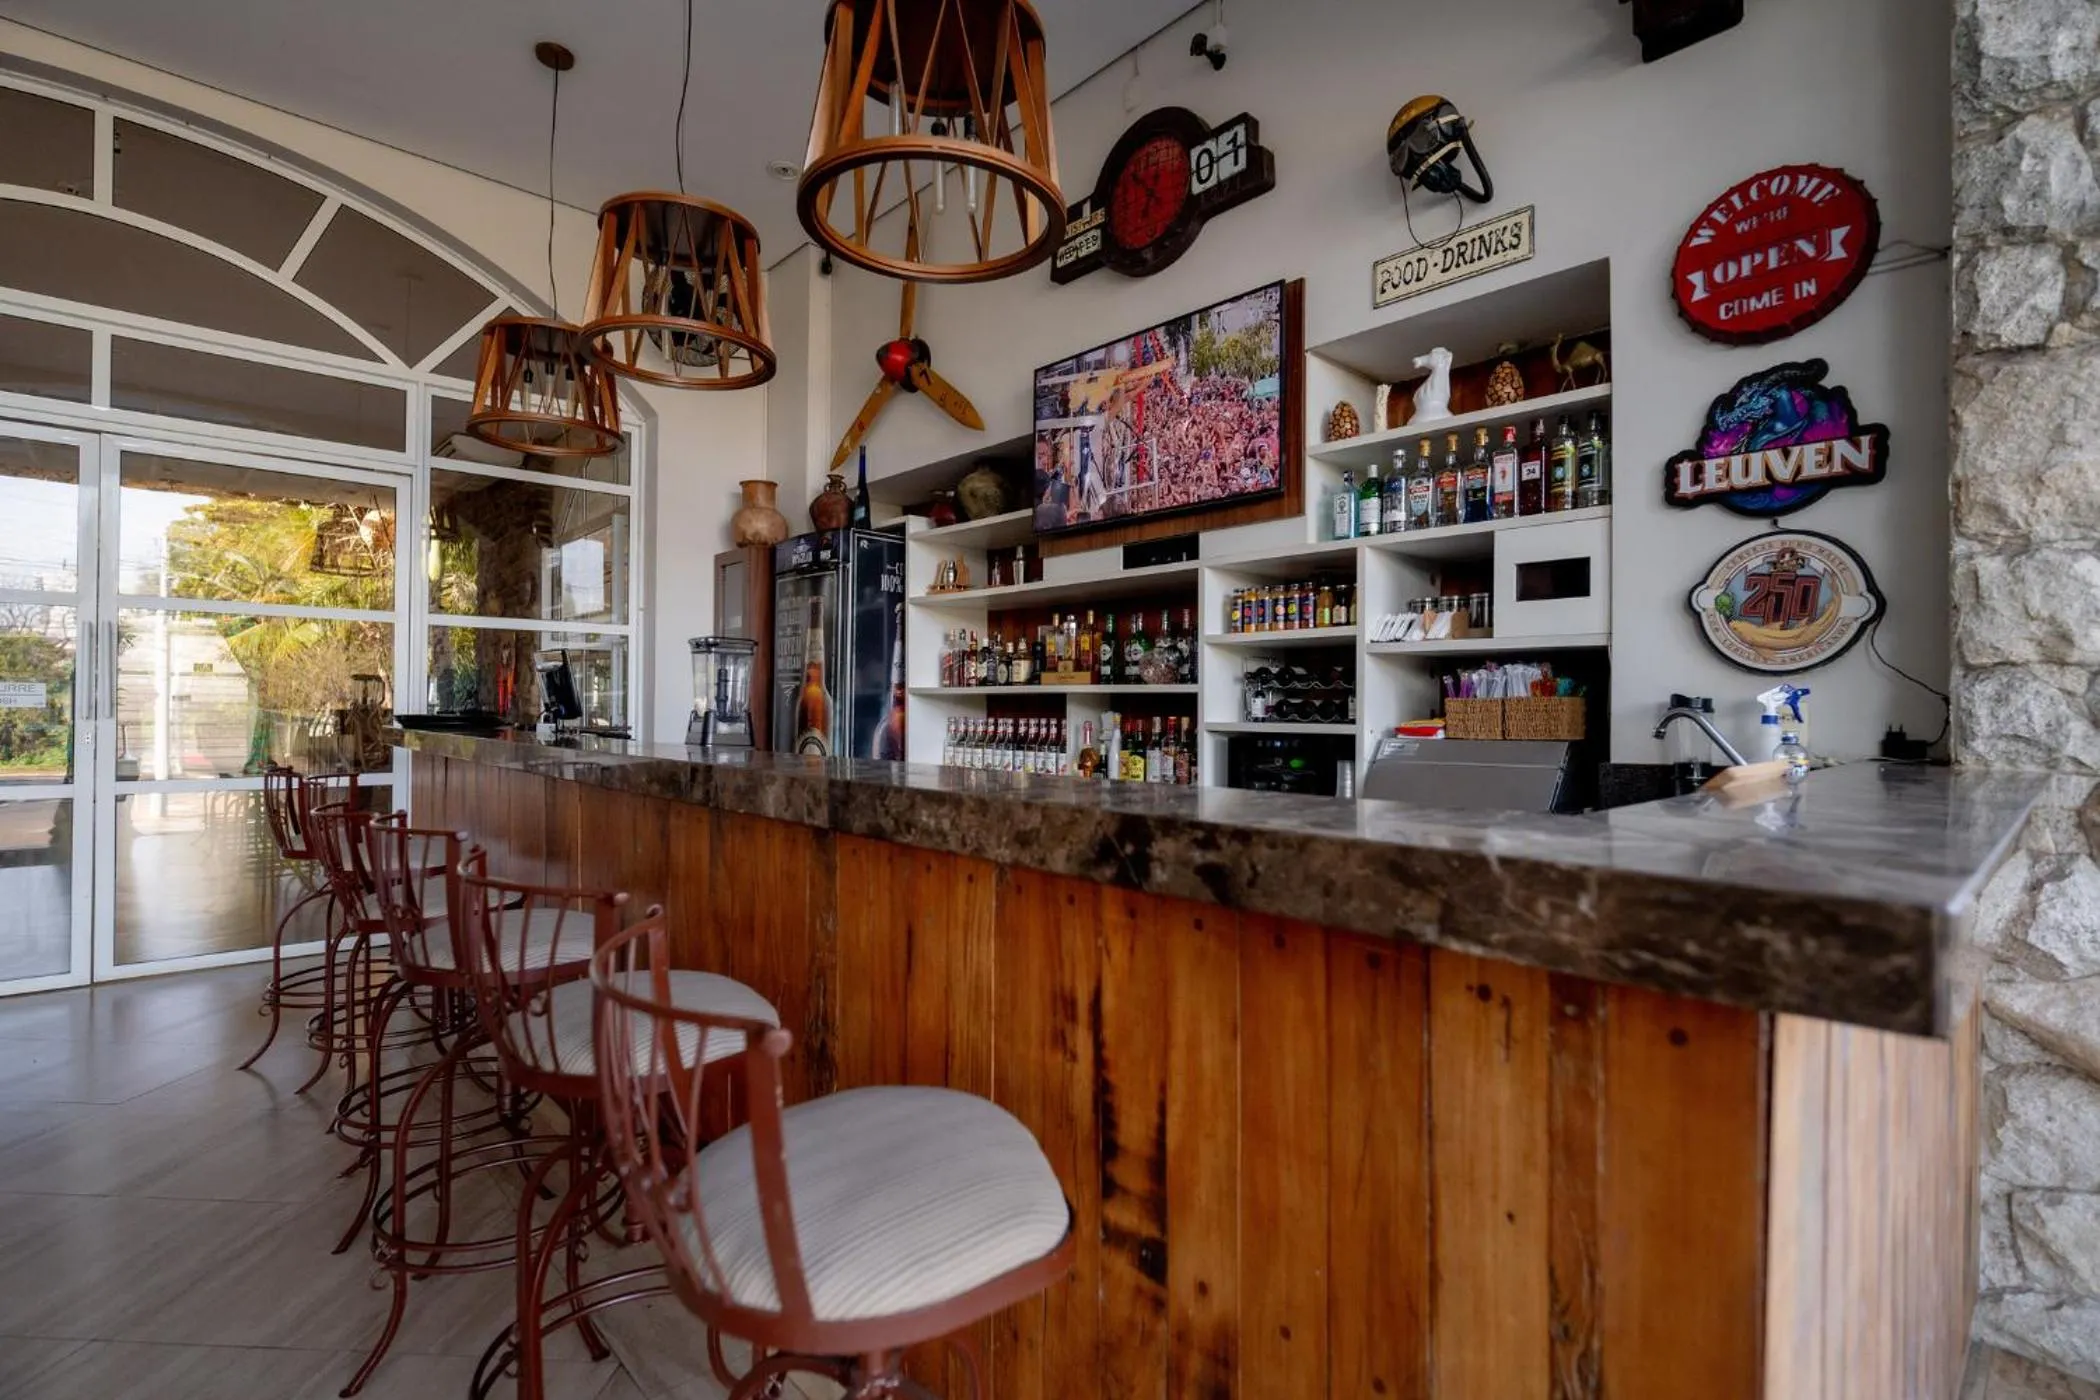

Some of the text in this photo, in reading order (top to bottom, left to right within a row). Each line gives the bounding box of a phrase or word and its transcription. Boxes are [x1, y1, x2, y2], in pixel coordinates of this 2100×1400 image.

[1688, 174, 1842, 248] WELCOME
[1440, 221, 1524, 274] DRINKS
[1713, 234, 1818, 284] OPEN
[1719, 277, 1818, 321] COME IN
[1674, 433, 1877, 499] LEUVEN
